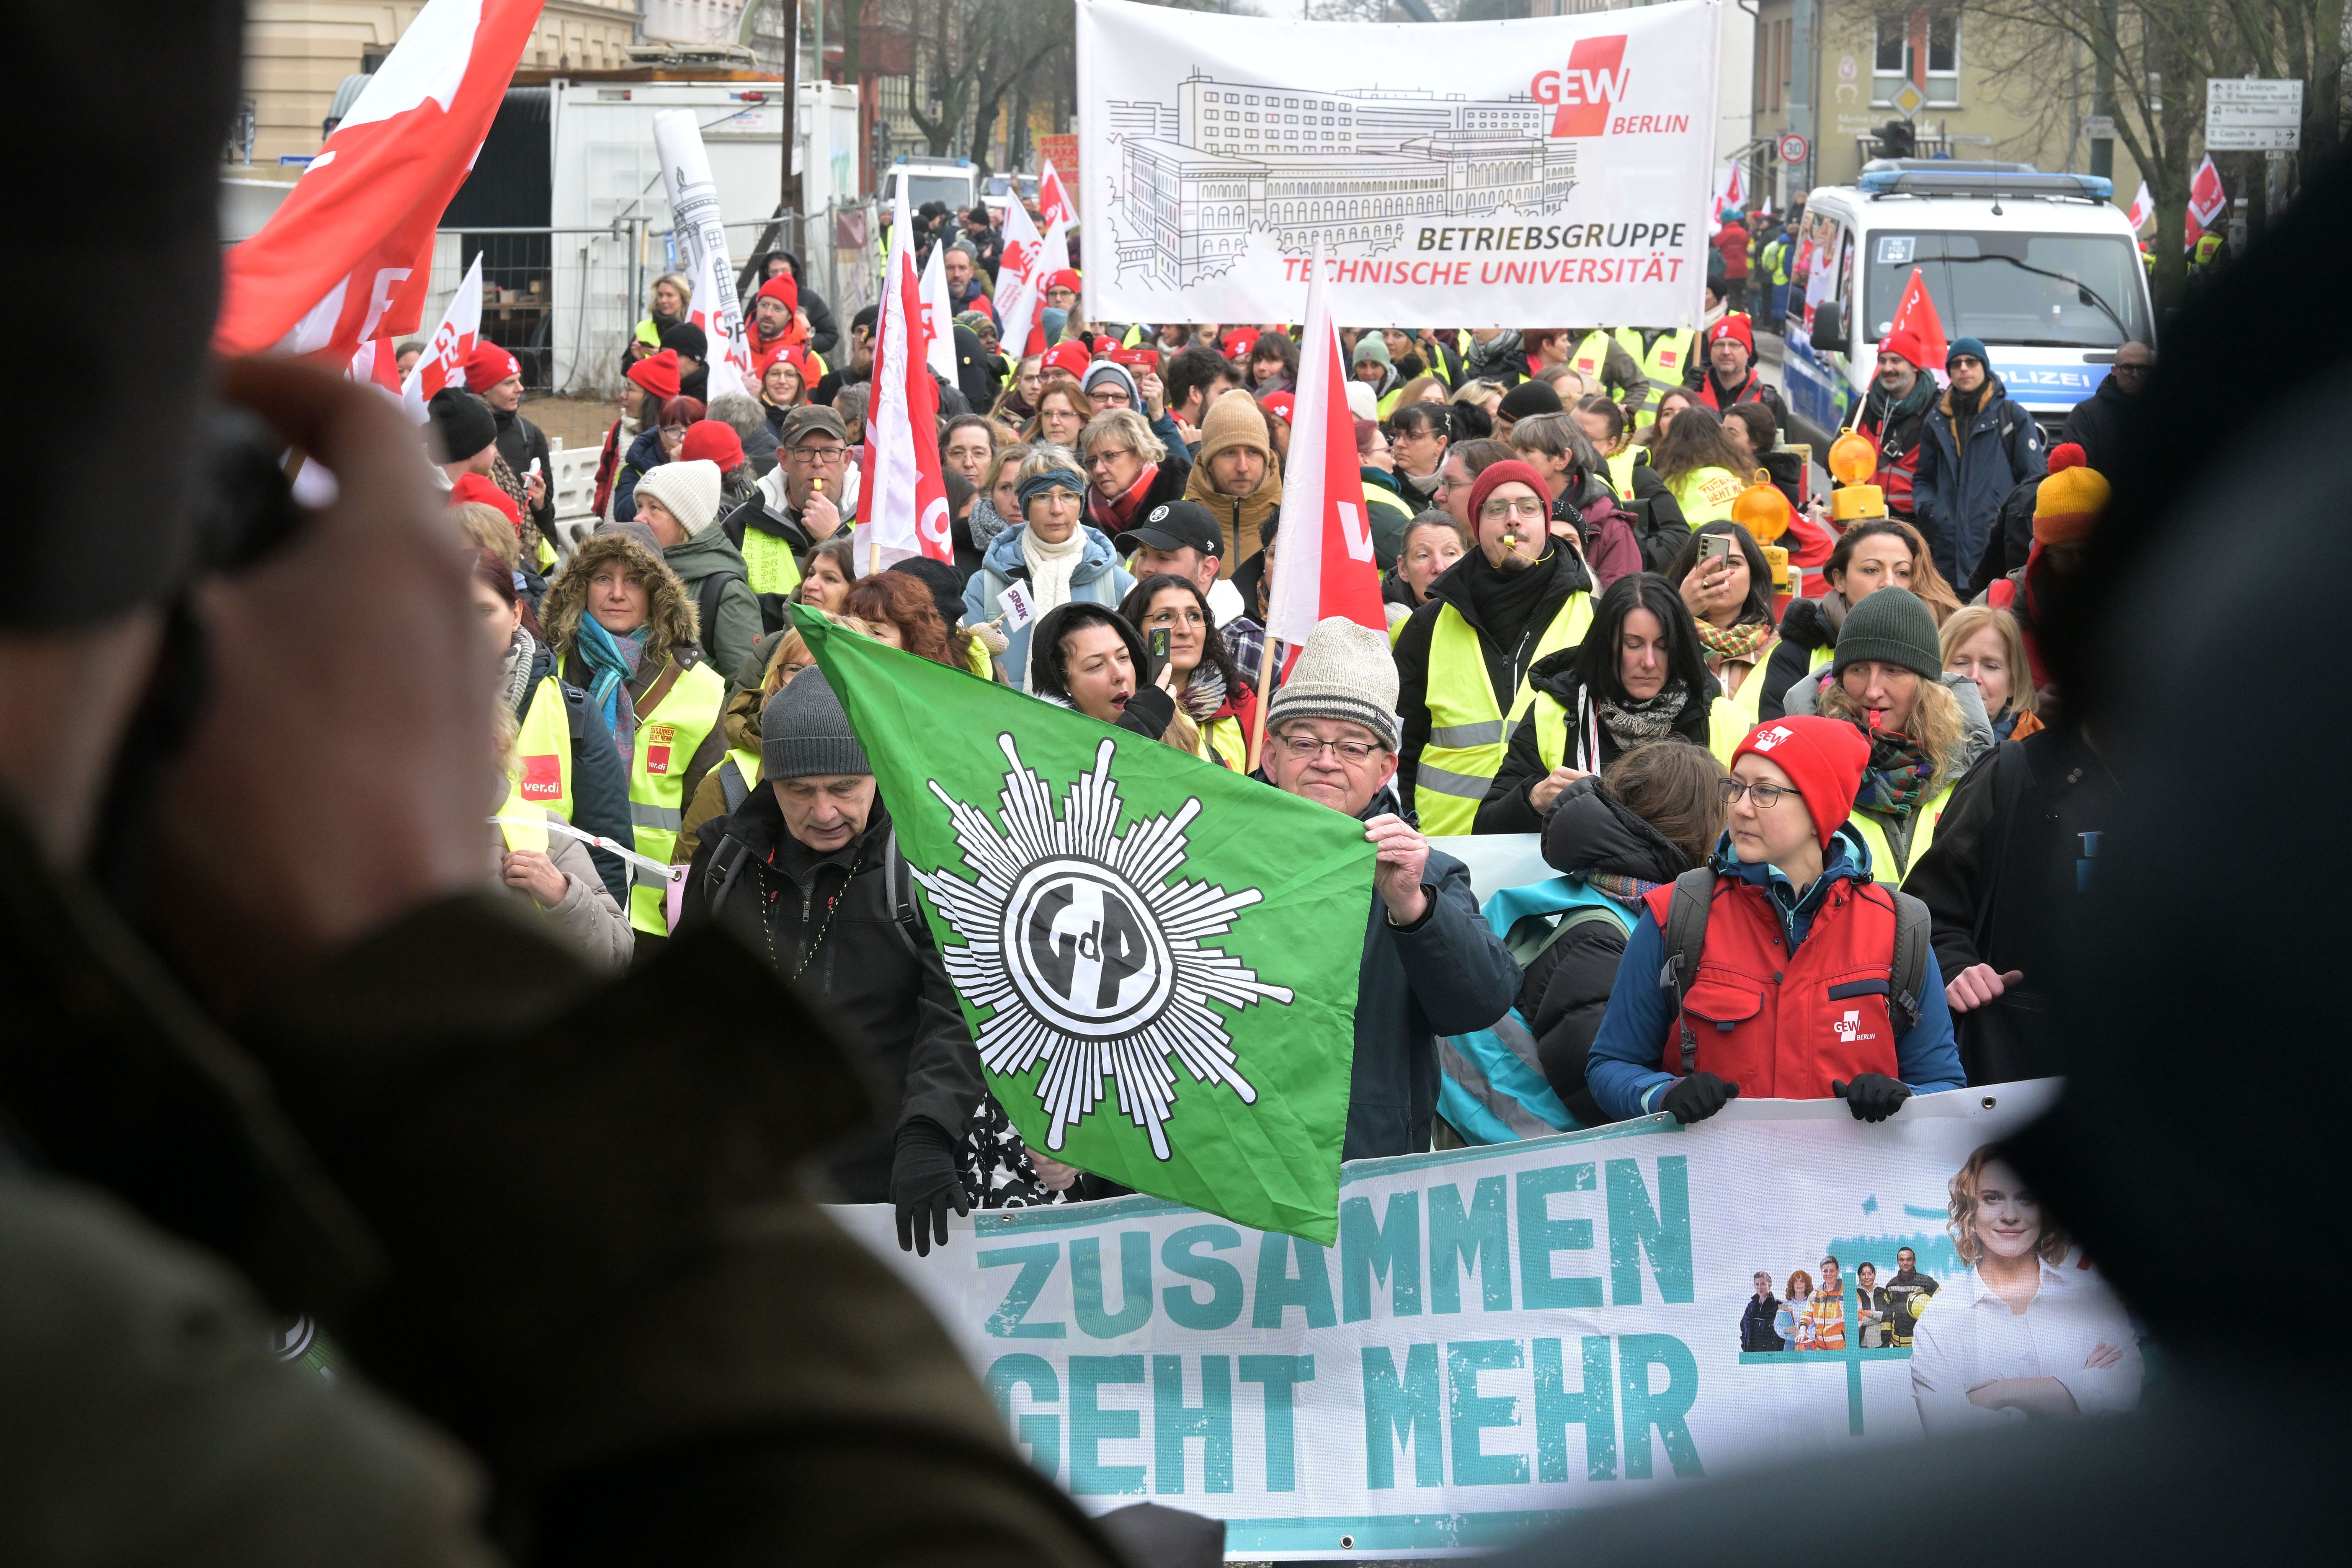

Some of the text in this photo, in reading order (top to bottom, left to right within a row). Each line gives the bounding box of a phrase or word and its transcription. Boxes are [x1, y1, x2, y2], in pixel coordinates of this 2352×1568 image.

[1531, 68, 1630, 105] GEW
[1612, 115, 1689, 135] BERLIN
[1784, 143, 1802, 155] 30
[1417, 223, 1686, 251] BETRIEBSGRUPPE
[1481, 252, 1683, 284] UNIVERSITÄT
[1995, 371, 2090, 387] OLIZEI
[1708, 487, 1730, 502] GEHT
[761, 541, 778, 549] 2009
[761, 551, 777, 559] 2011
[761, 559, 778, 568] 2013
[761, 568, 778, 576] 2015
[760, 576, 776, 585] 2017
[1008, 590, 1028, 620] STREIK
[651, 727, 675, 736] ZUSAMMEN
[1757, 730, 1787, 746] GEW
[649, 761, 666, 771] ver.di
[524, 782, 559, 793] ver.di
[1028, 883, 1147, 1009] GdP
[1834, 1020, 1860, 1033] GEW
[977, 1155, 1694, 1339] ZUSAMMEN
[985, 1333, 1706, 1495] GEHT MEHR
